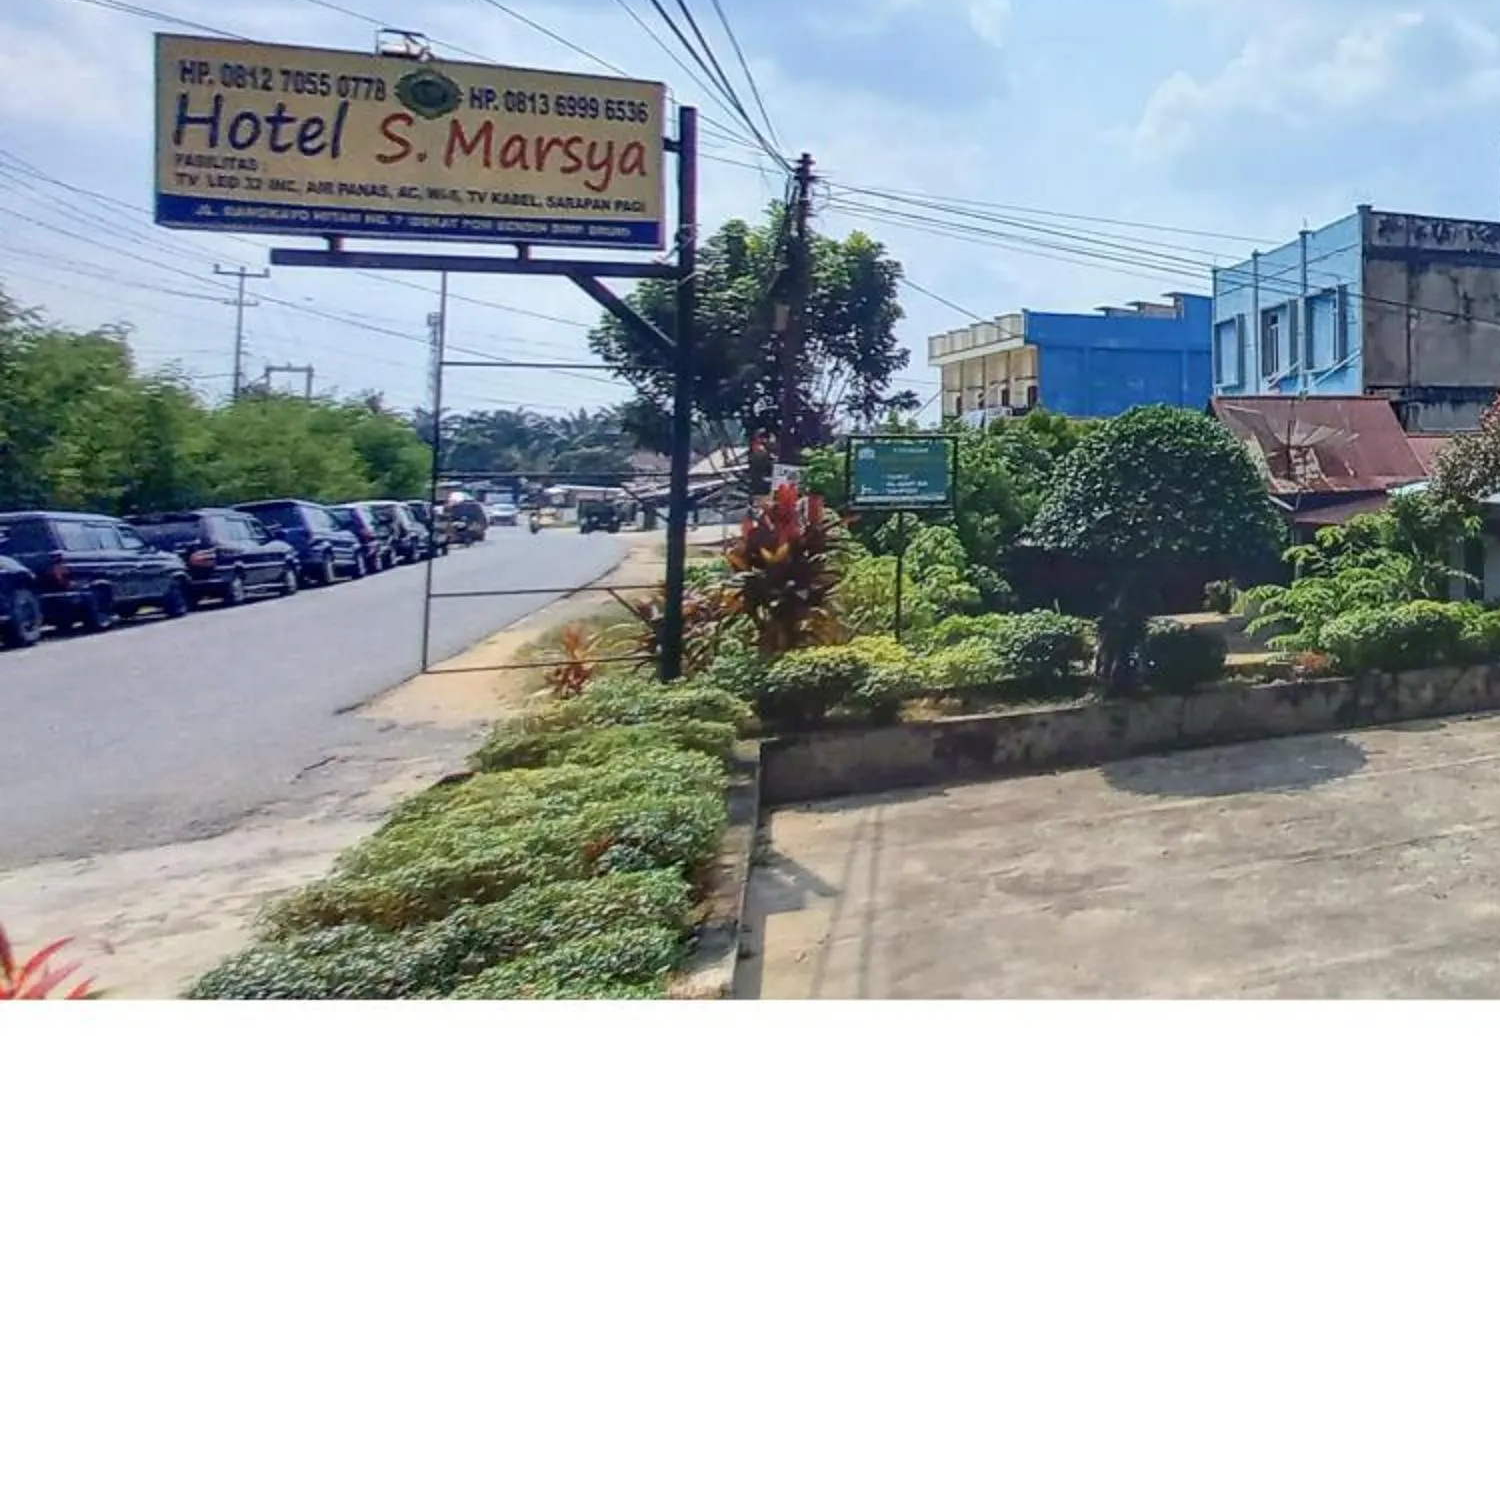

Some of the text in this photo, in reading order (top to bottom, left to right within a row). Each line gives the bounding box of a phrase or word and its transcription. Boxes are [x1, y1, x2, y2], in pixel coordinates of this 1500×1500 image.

[178, 59, 387, 101] HP. 0812 7055 0778
[468, 87, 649, 124] HP. 0813 6999 6536
[172, 91, 648, 192] Hotel S. Marsya
[175, 171, 199, 188] TV
[207, 174, 241, 190] LED
[466, 189, 489, 205] TV
[545, 195, 611, 212] SARAPAN
